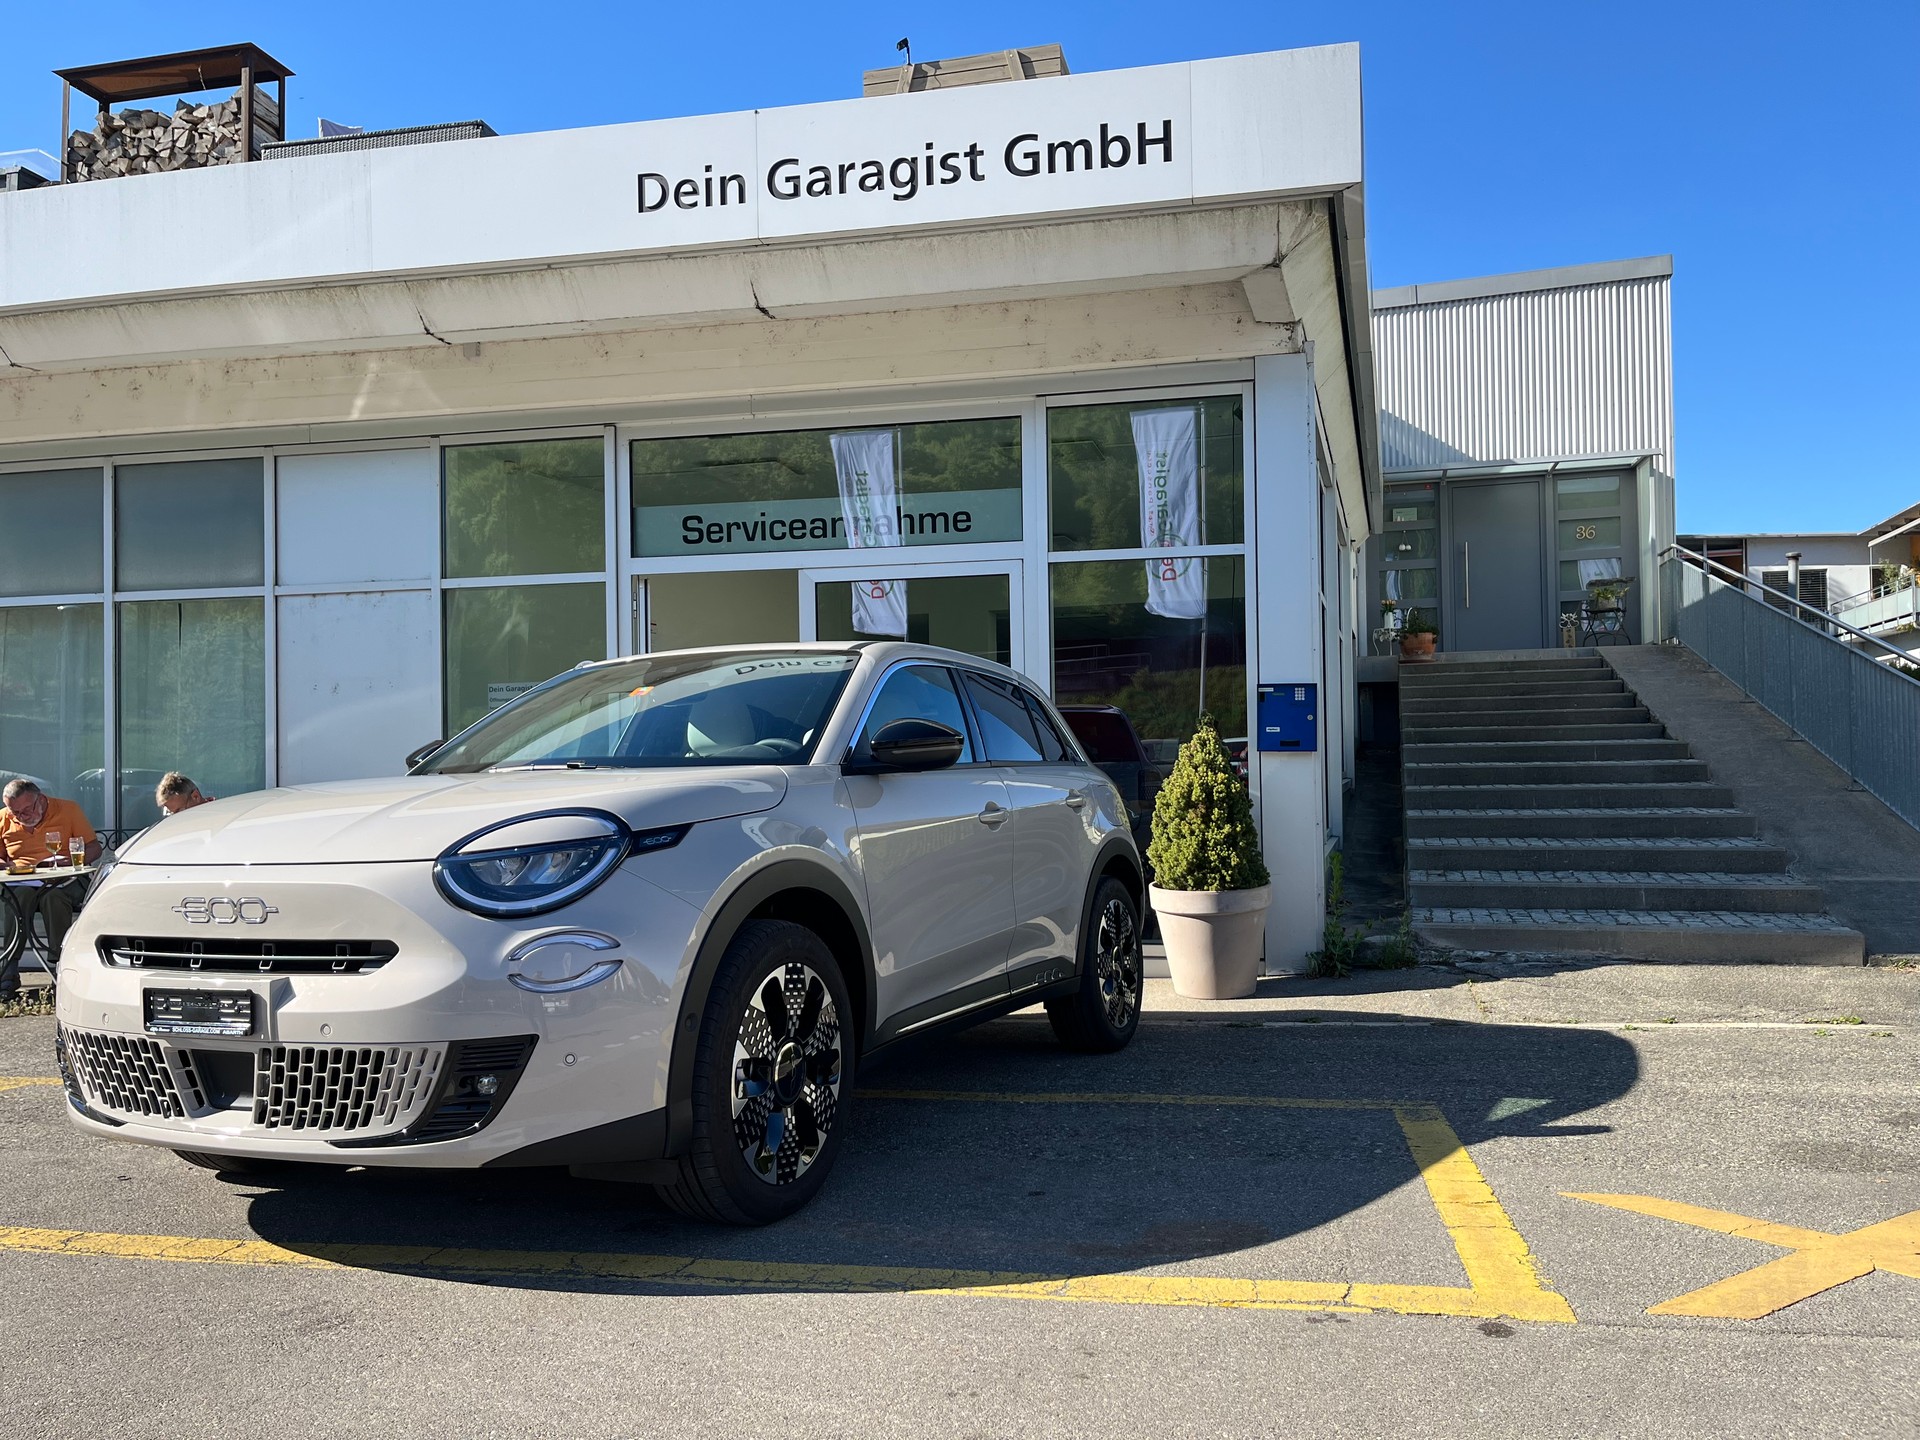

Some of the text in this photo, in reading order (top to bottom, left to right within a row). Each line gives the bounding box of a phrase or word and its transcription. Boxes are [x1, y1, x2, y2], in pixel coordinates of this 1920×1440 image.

[636, 119, 1174, 214] Dein Garagist GmbH
[1576, 525, 1596, 540] 36
[181, 897, 268, 924] 600
